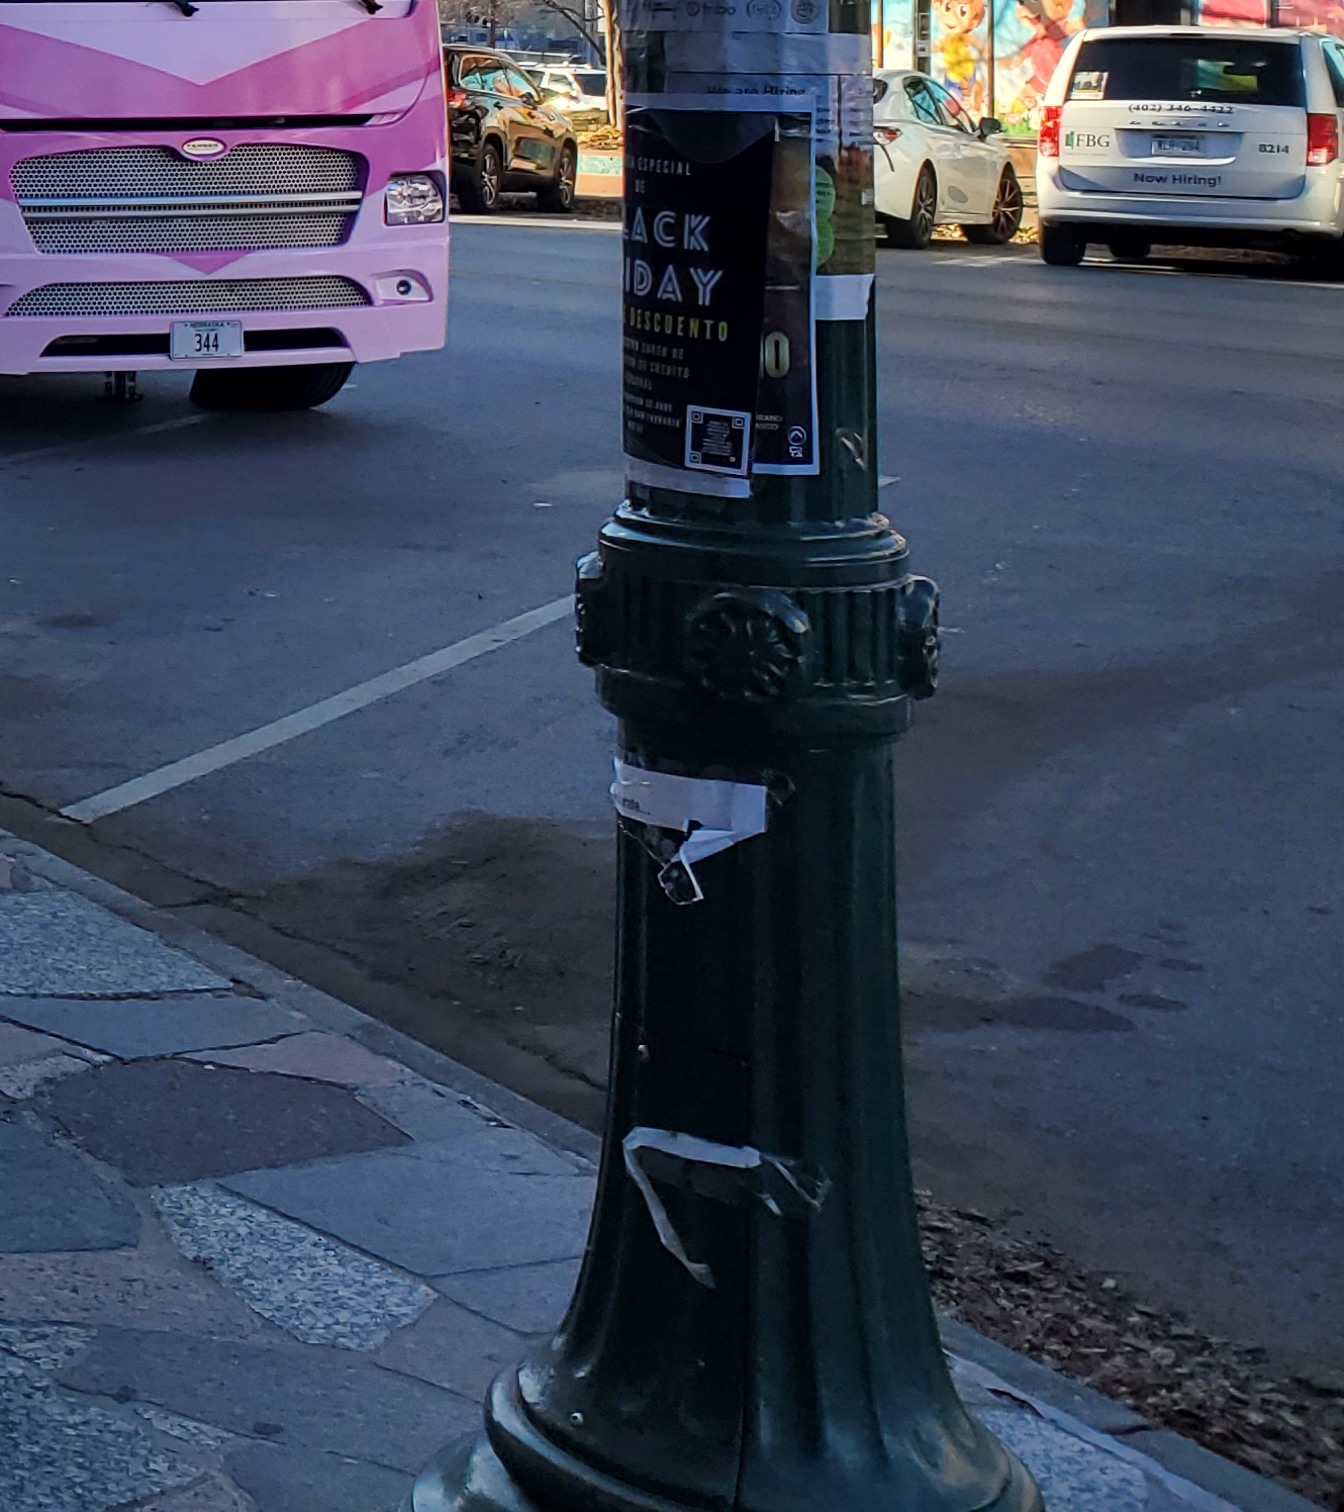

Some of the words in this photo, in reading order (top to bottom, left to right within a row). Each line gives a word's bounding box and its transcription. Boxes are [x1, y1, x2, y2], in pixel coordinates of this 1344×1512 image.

[1076, 134, 1111, 148] FBG
[1132, 172, 1168, 184] Now
[1171, 172, 1222, 188] Hiring!
[193, 332, 220, 353] 344
